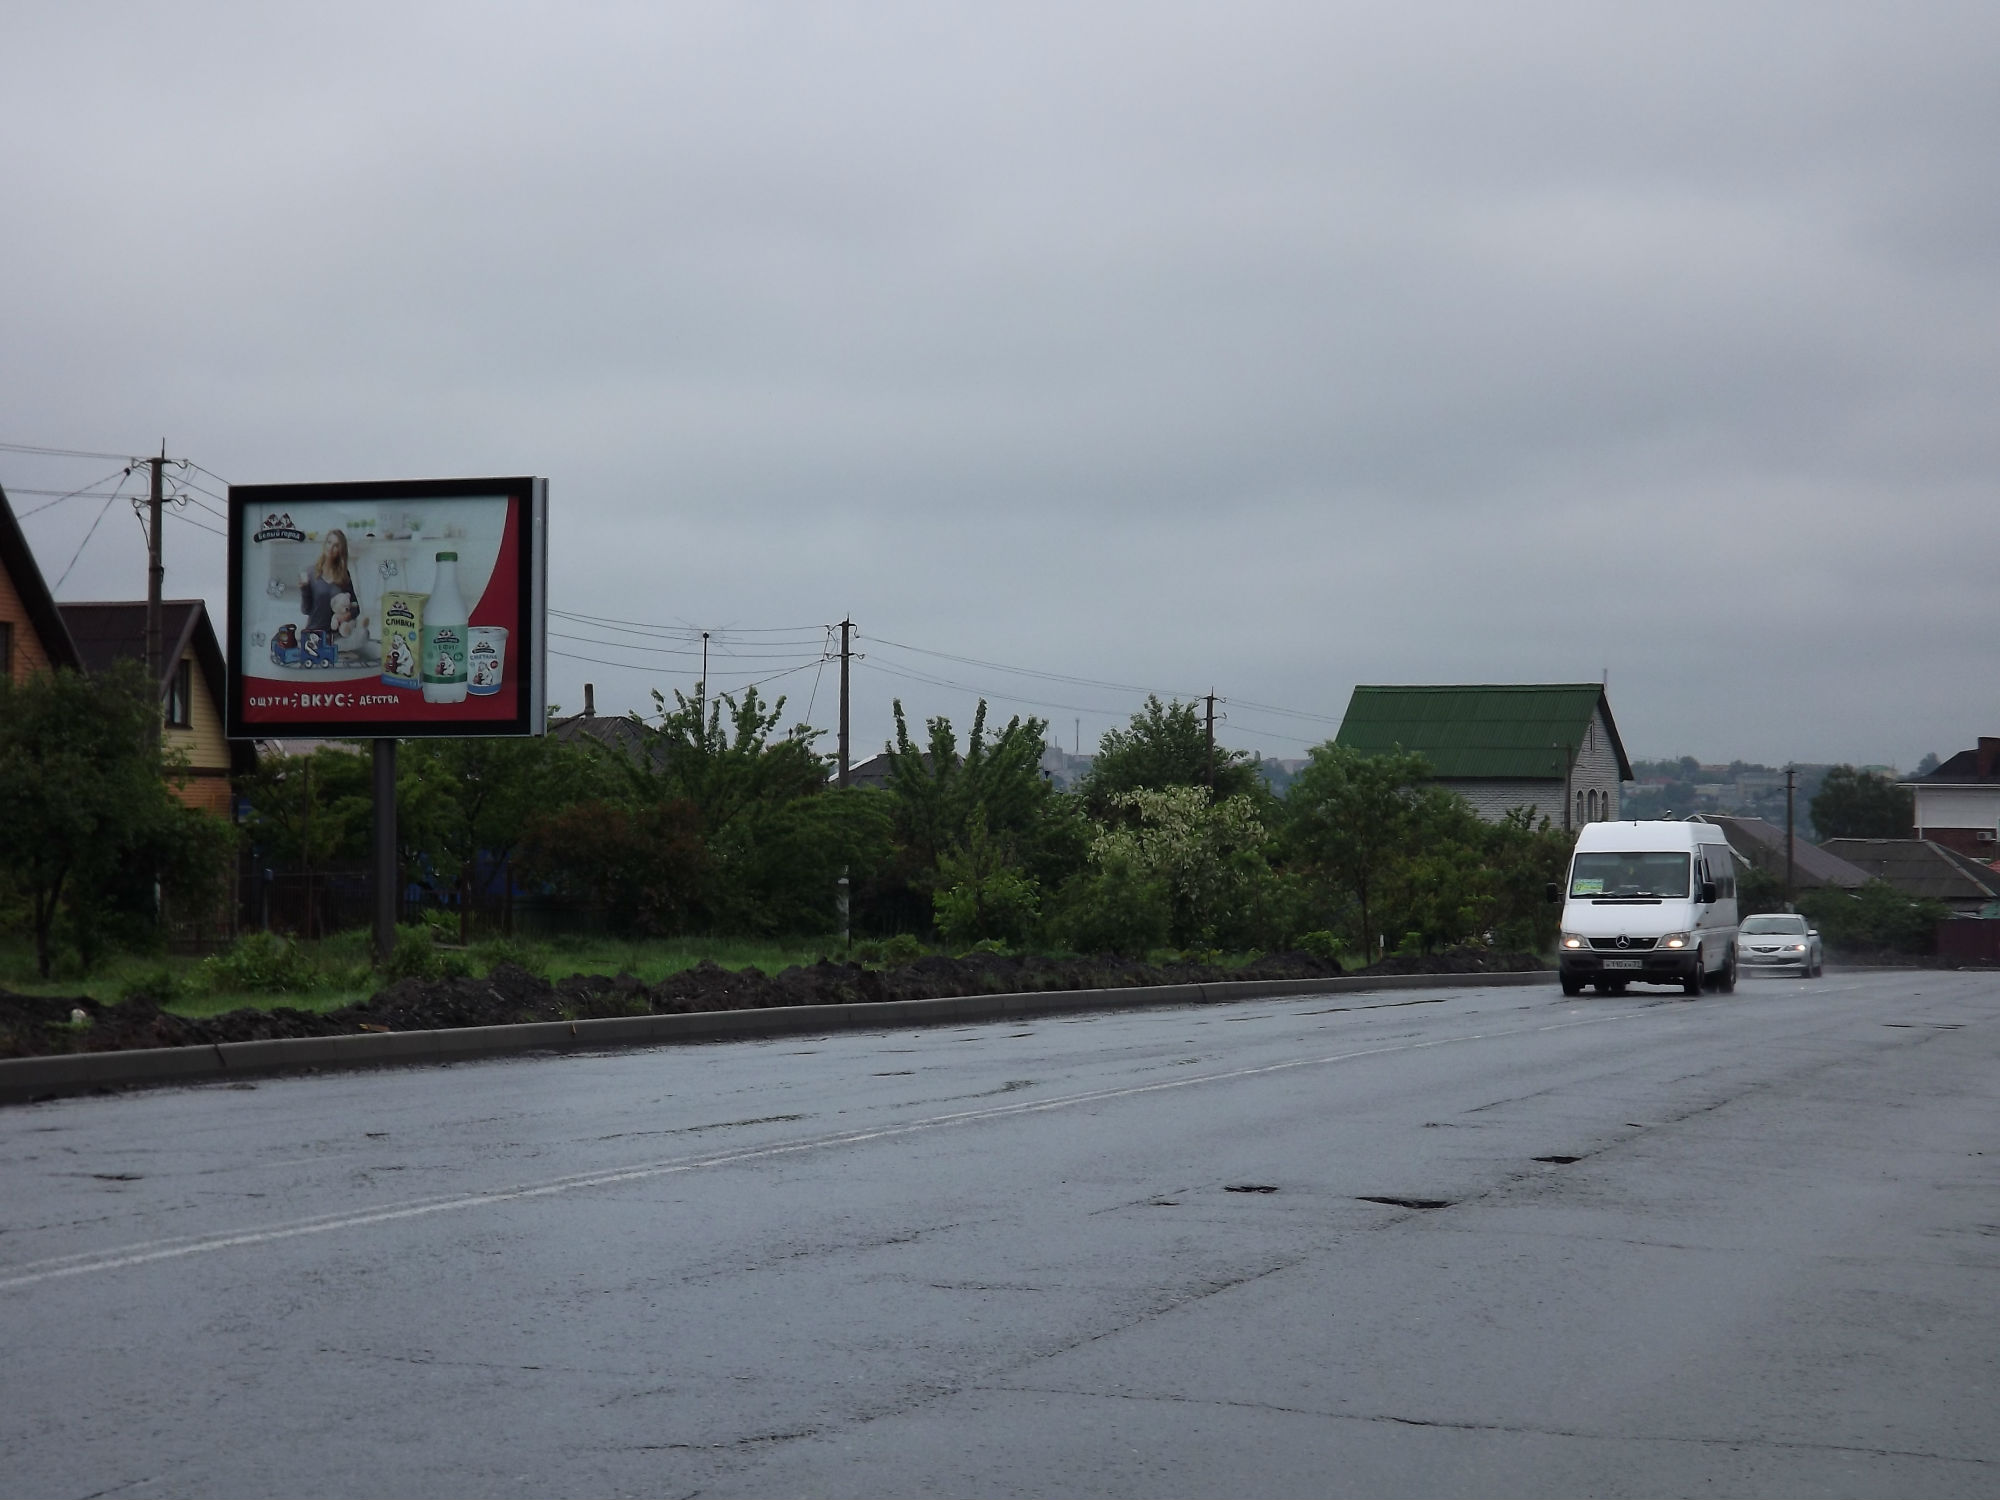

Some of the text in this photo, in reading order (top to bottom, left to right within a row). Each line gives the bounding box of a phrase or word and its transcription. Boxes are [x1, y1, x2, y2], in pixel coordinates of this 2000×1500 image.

[385, 618, 415, 629] СЛИВКИ
[249, 693, 399, 707] ОЩУТИ ВКУС ДЕТСТВА
